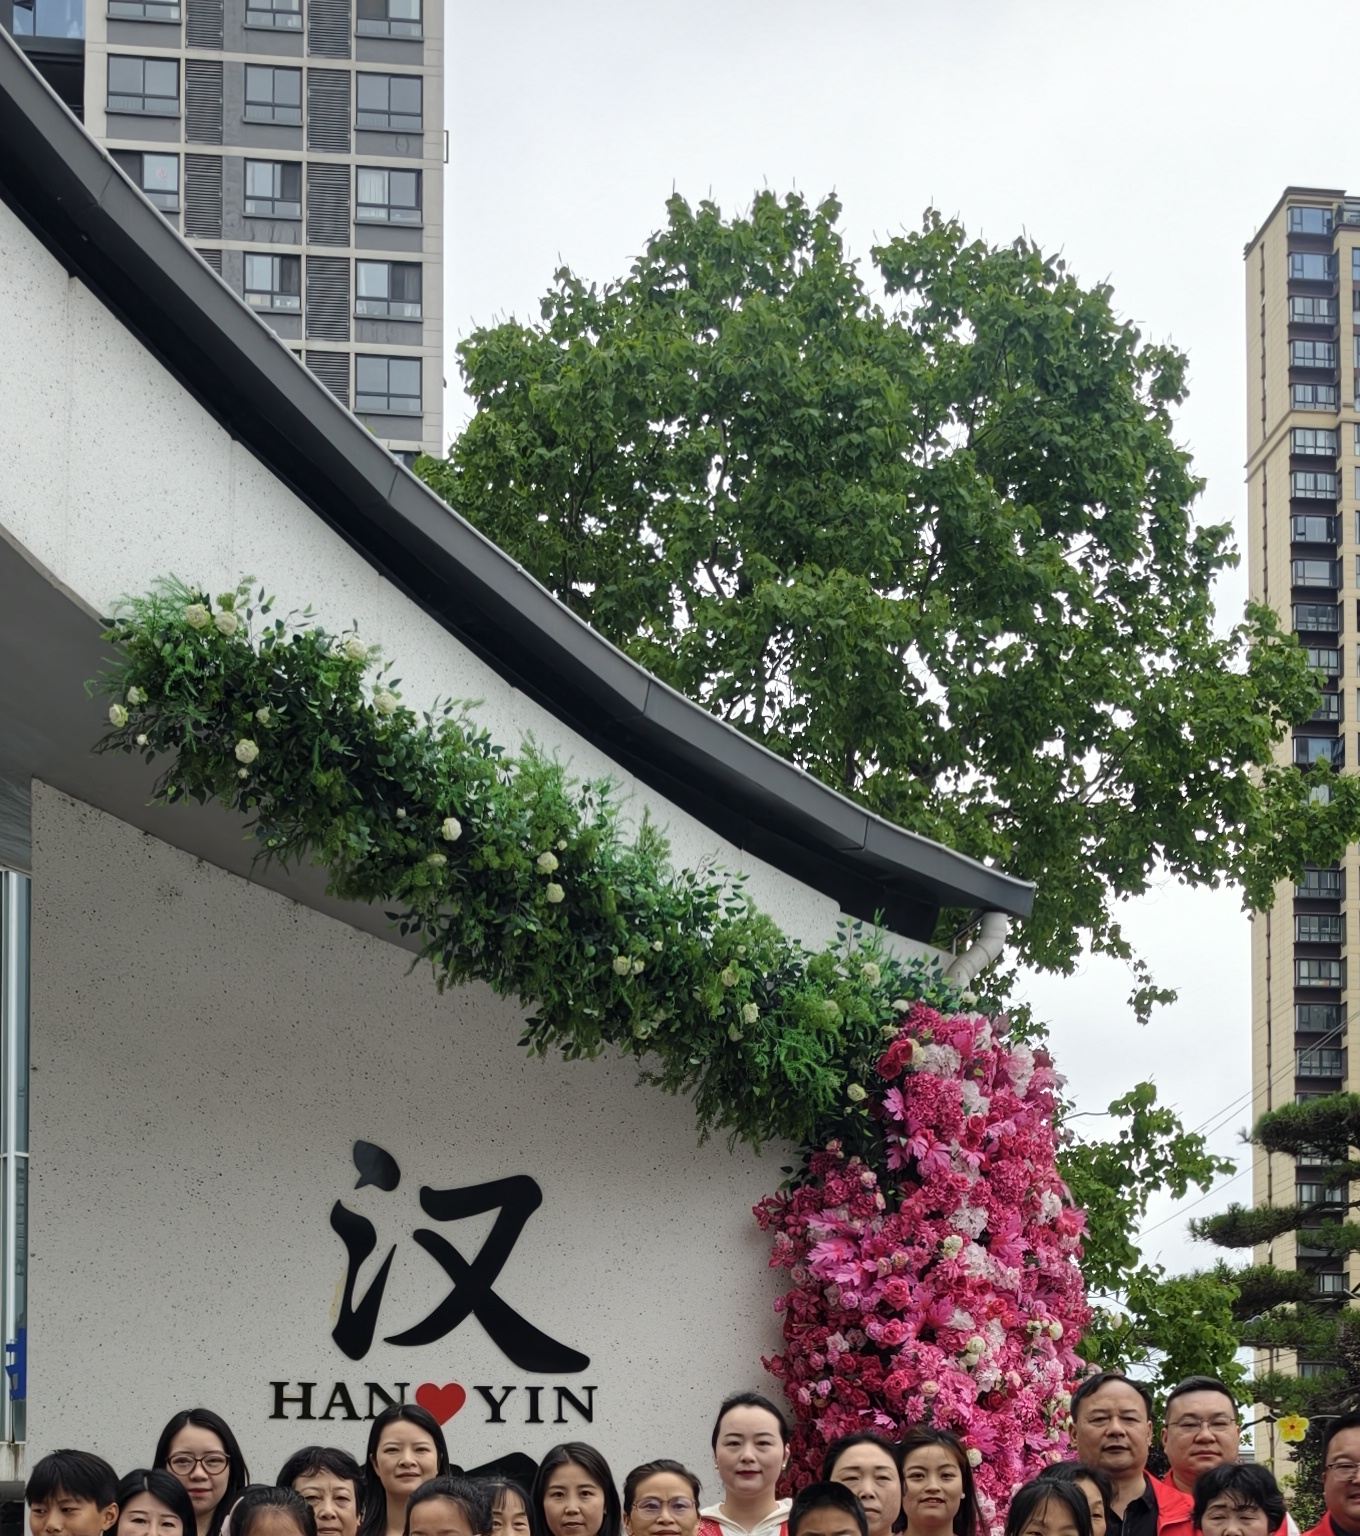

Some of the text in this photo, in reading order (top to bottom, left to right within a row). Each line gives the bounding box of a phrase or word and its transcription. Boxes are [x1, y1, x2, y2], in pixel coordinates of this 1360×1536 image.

[329, 1139, 591, 1374] 汉
[268, 1381, 598, 1424] HAN YIN
